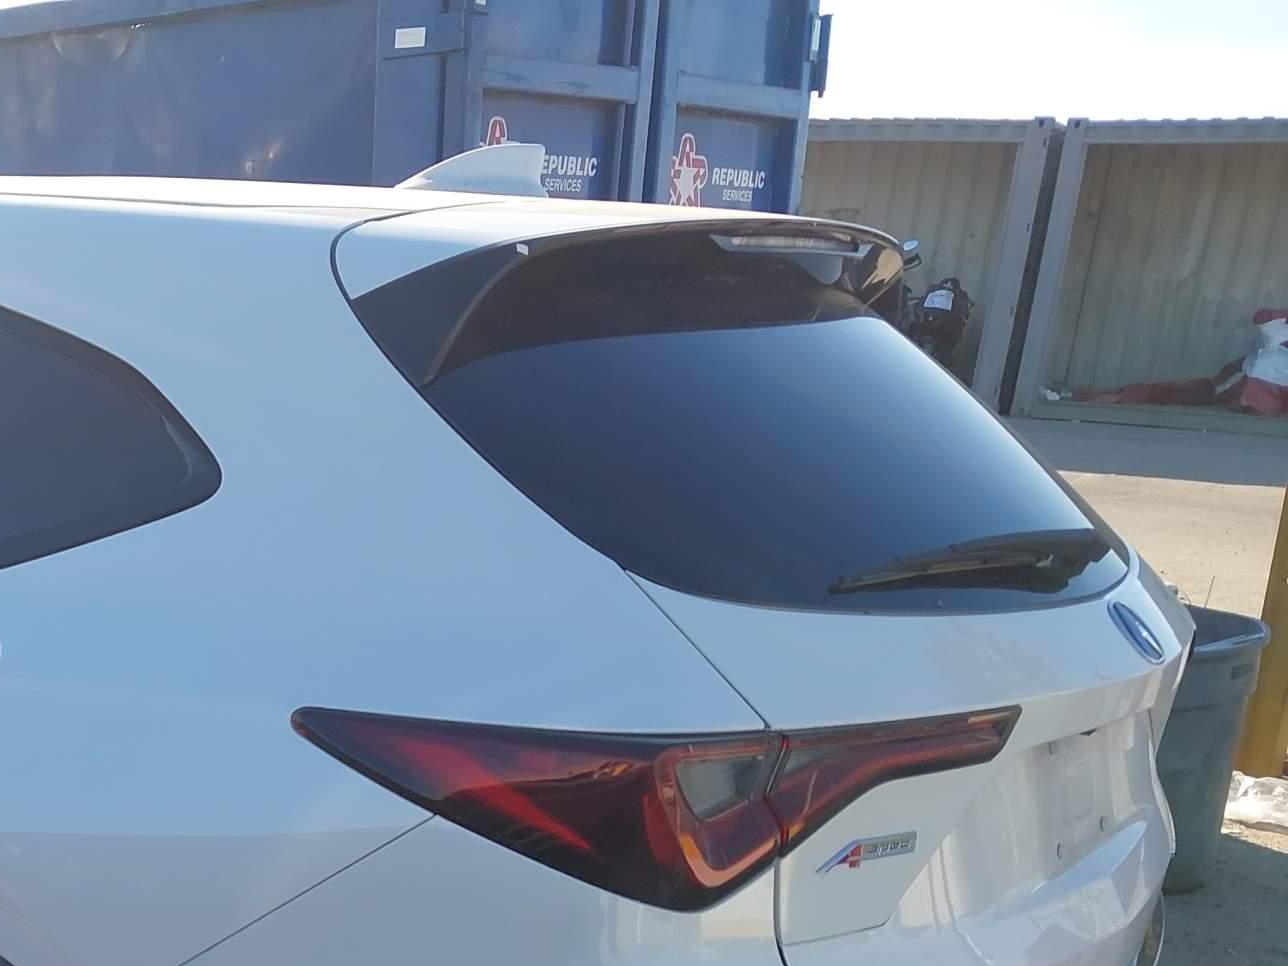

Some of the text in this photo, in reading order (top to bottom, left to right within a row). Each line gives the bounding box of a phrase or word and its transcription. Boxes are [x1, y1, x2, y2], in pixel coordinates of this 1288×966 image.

[541, 154, 598, 177] EPUBLIC
[544, 178, 582, 192] SERVICES
[712, 167, 766, 190] REPUBLIC
[722, 189, 753, 203] SERVICES
